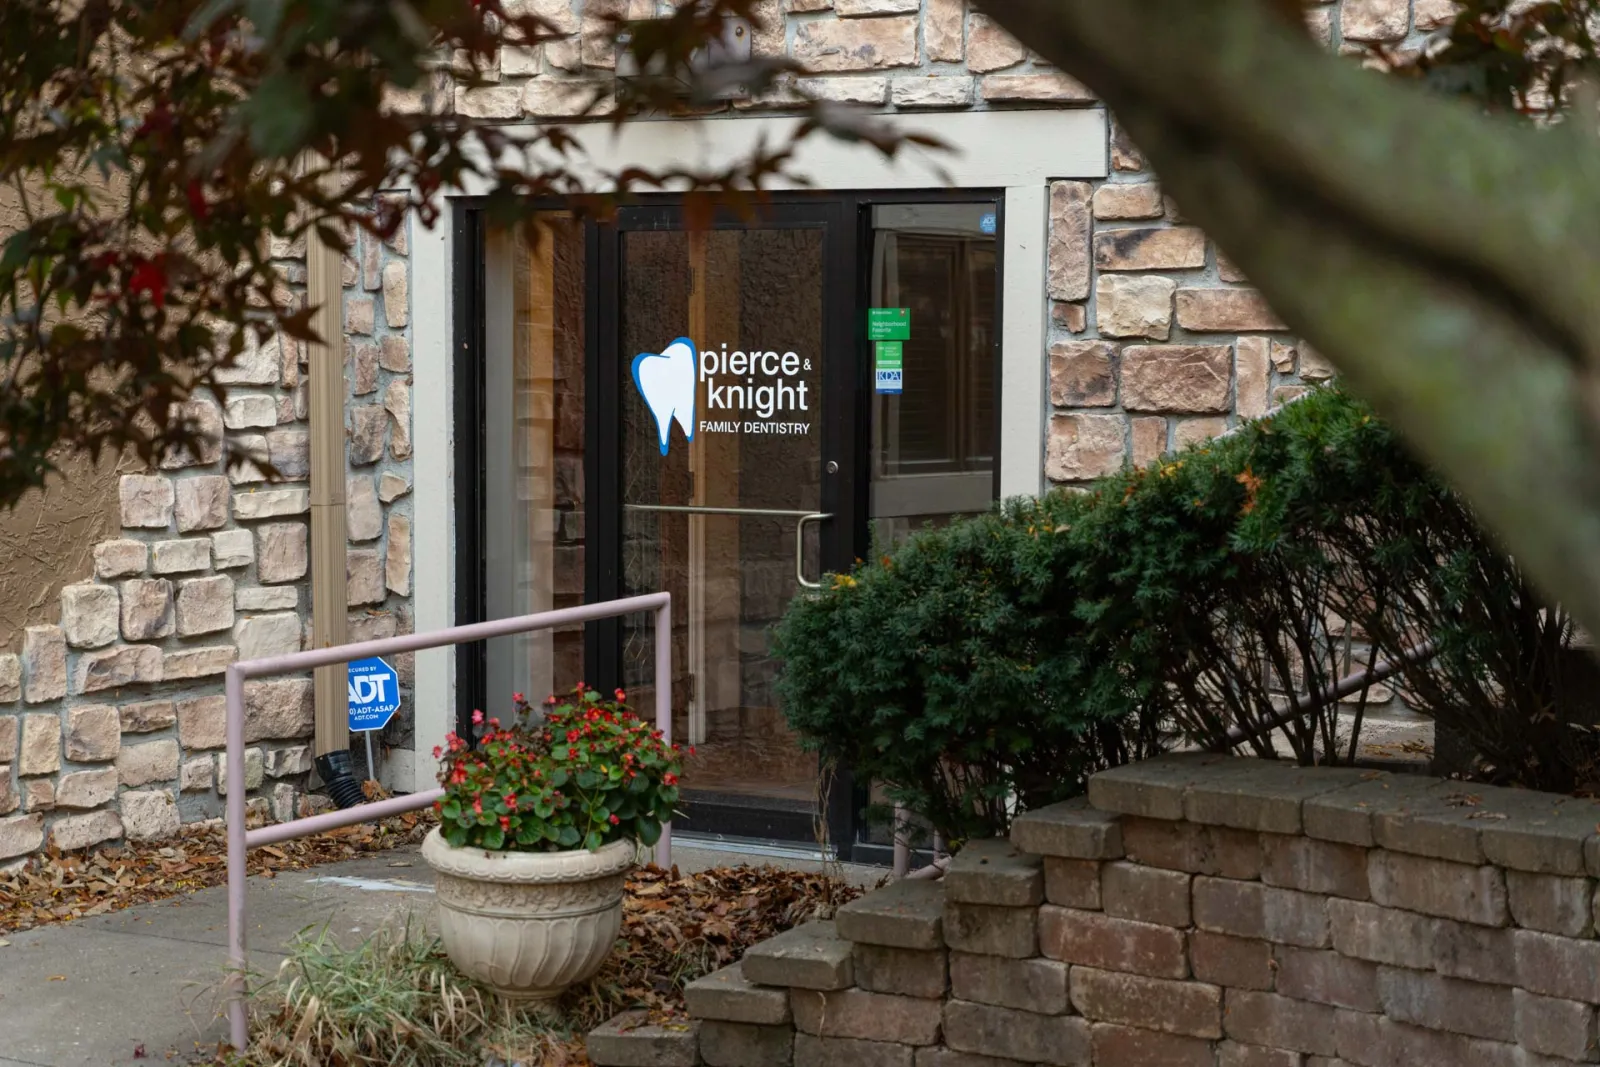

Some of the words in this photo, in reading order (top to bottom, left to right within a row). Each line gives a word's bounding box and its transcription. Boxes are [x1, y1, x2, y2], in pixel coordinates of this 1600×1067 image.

[699, 343, 800, 382] pierce
[803, 358, 812, 371] &
[878, 371, 901, 381] KDA
[708, 377, 809, 419] knight
[699, 421, 741, 433] FAMILY
[744, 422, 811, 435] DENTISTRY
[357, 704, 394, 714] ADT-ASAP
